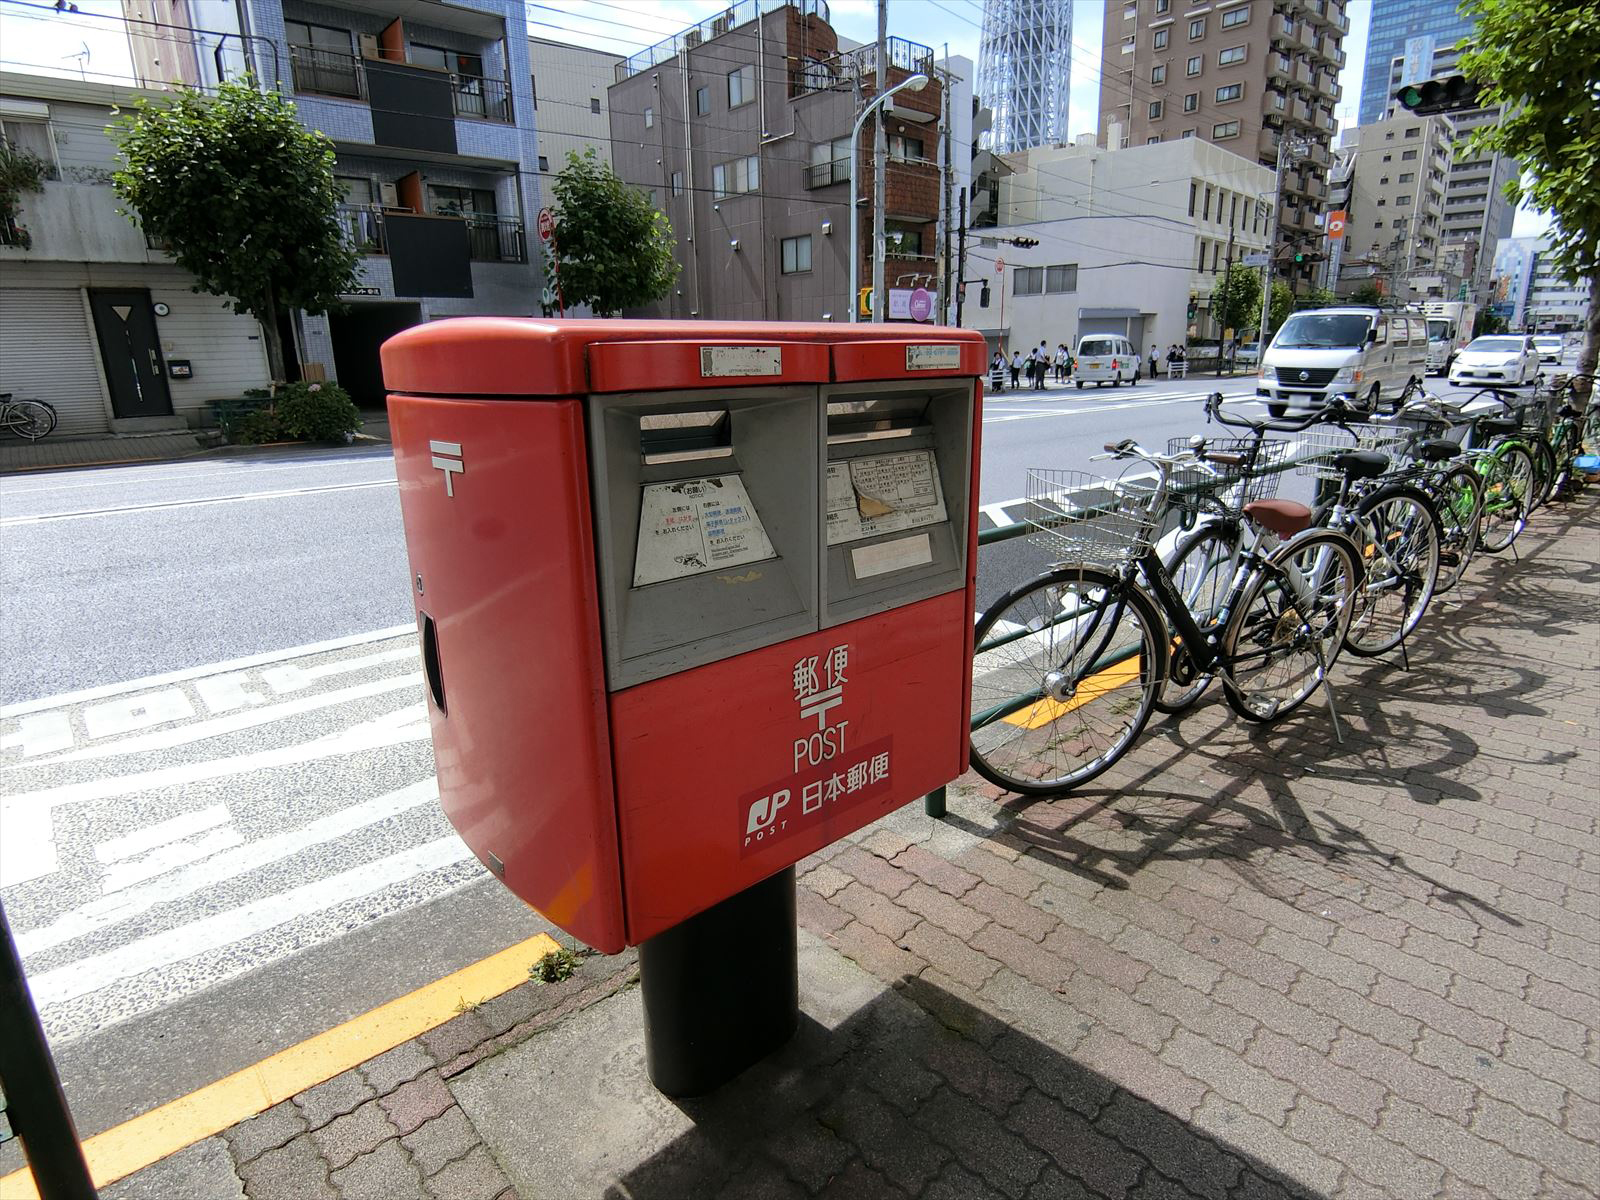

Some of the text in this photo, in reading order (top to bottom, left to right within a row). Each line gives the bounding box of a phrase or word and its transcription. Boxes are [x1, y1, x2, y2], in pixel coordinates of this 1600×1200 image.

[793, 644, 849, 701] 郵便
[794, 720, 849, 774] POST
[802, 751, 889, 815] 日本郵便
[744, 819, 788, 848] POST
[746, 789, 791, 835] JP
